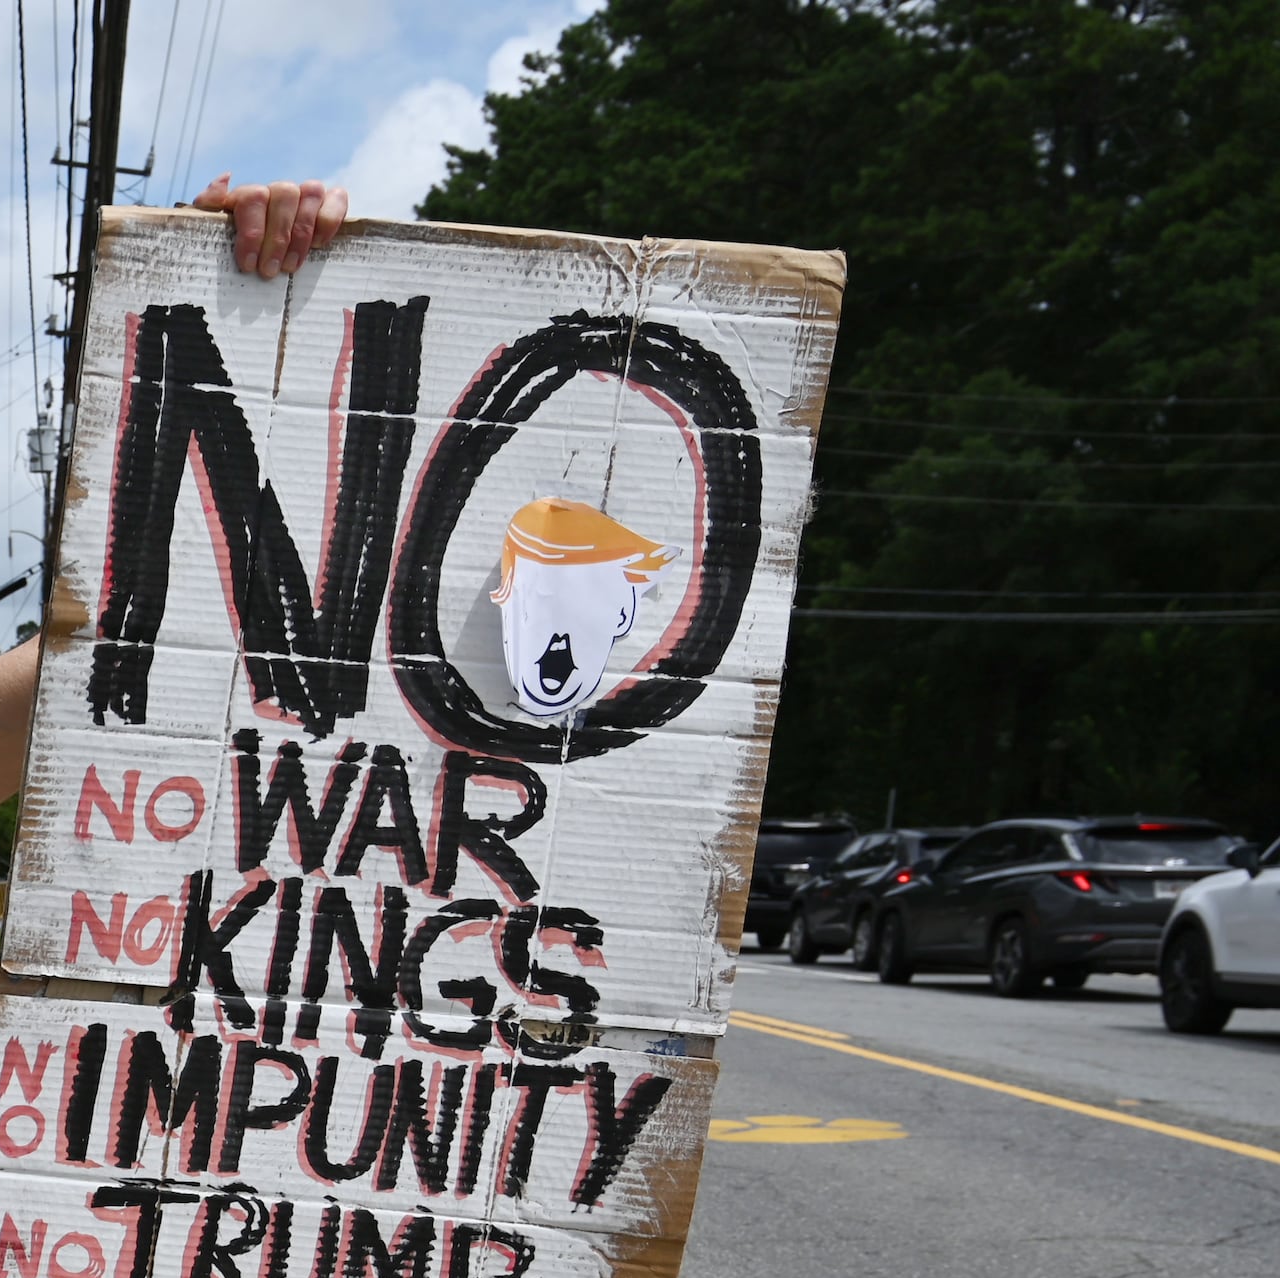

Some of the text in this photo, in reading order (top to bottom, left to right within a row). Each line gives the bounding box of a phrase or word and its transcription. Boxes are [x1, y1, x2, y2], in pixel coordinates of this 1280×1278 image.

[87, 296, 762, 764] NO
[75, 729, 549, 899] NO WAR
[65, 870, 604, 1060] NO KINGS
[60, 1023, 671, 1209] IMPUNITY
